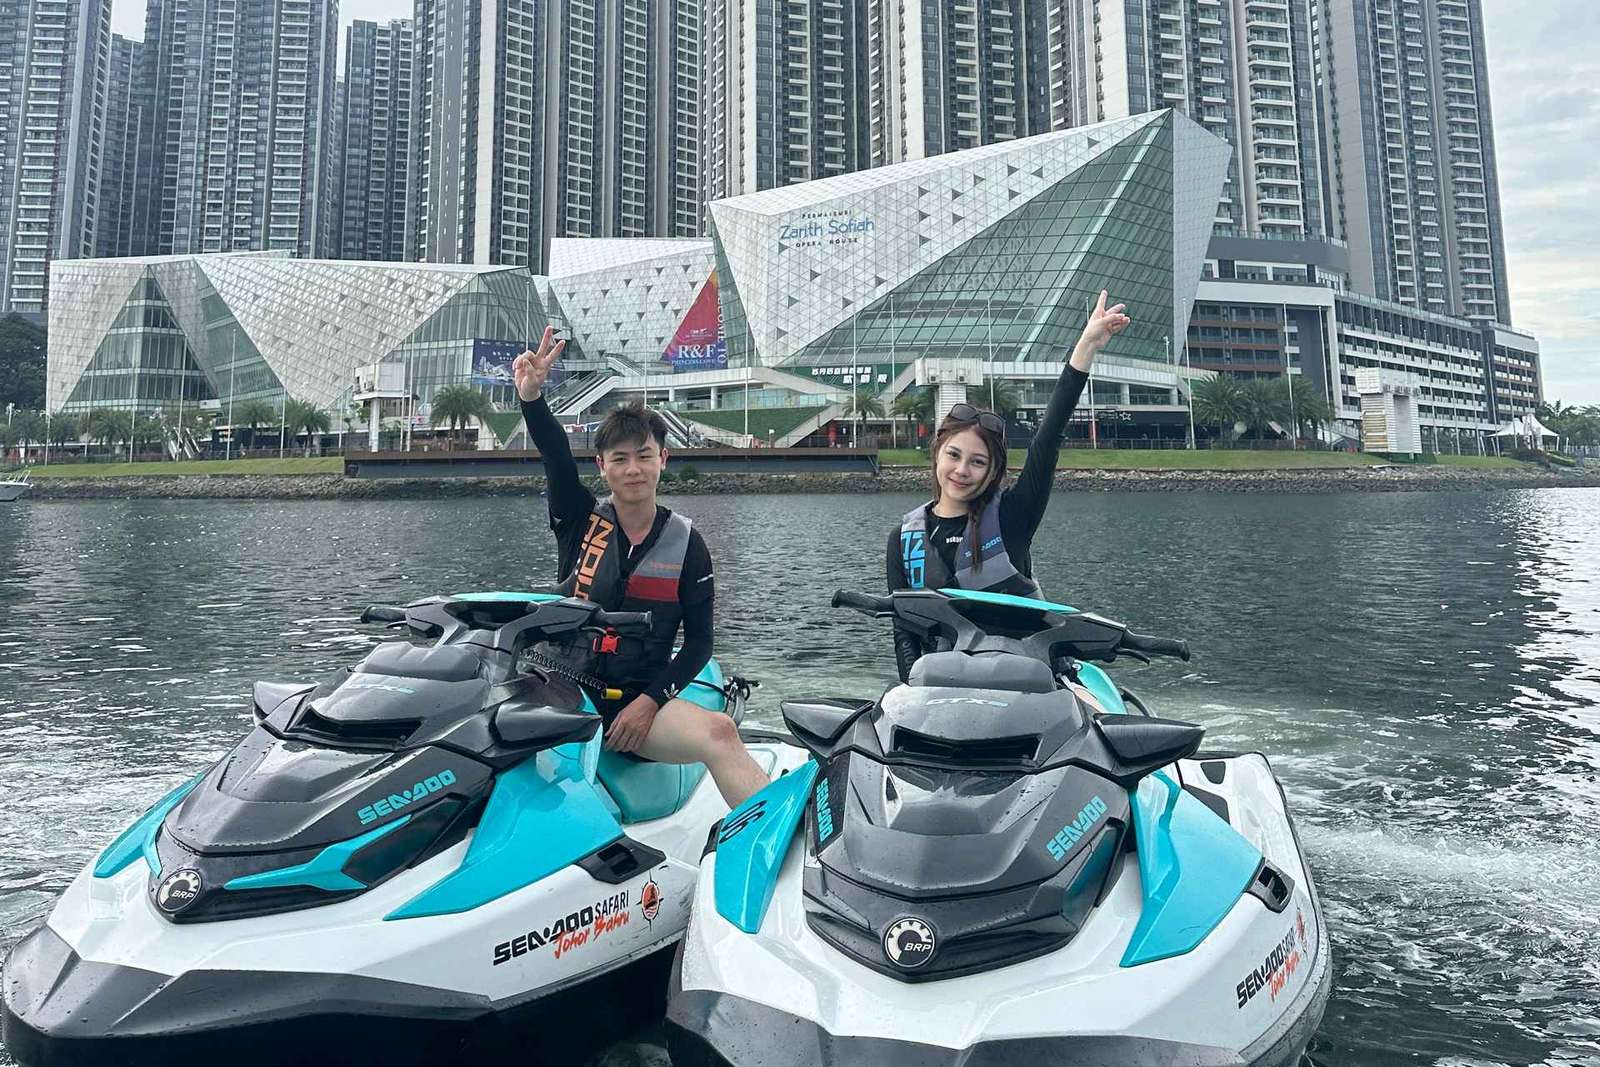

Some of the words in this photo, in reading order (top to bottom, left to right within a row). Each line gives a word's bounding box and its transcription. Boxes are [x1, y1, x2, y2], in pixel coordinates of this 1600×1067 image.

[780, 221, 823, 240] Zarith
[828, 217, 875, 235] Sofiah
[829, 237, 858, 245] HOUSE
[678, 343, 716, 359] R&F
[171, 890, 195, 899] BRP
[595, 889, 629, 919] SAFARI
[904, 942, 932, 952] BRP
